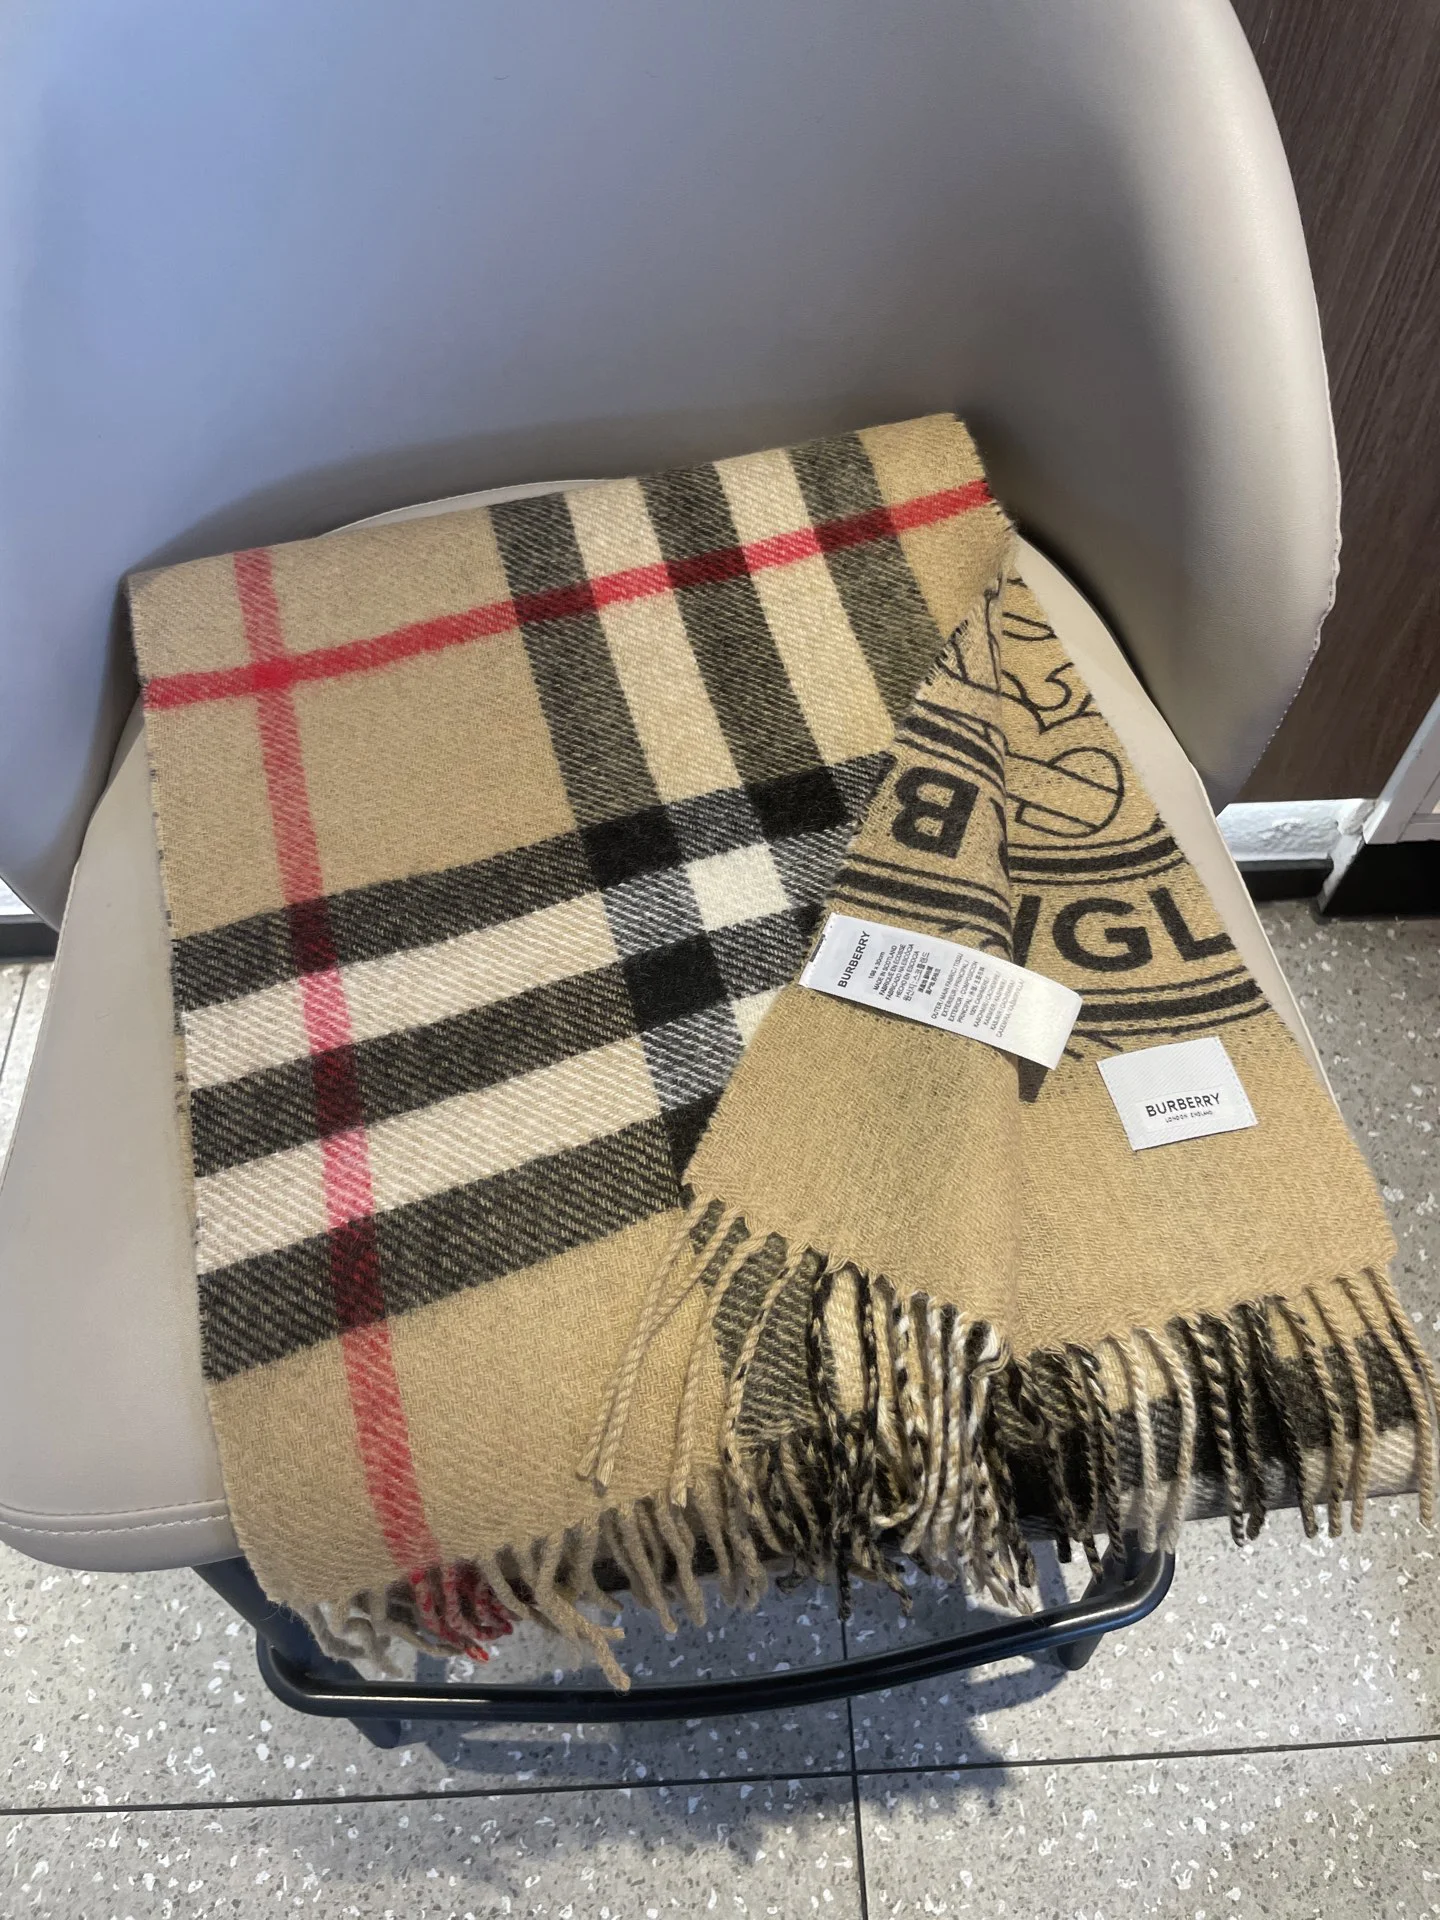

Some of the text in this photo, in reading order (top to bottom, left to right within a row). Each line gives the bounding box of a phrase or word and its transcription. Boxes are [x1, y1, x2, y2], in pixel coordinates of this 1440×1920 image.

[837, 930, 871, 988] BURBERRY
[872, 977, 884, 991] MADE
[882, 945, 898, 971] SCOTLAND
[885, 973, 902, 1001] FABRICADO
[944, 969, 957, 987] FABRIC
[895, 979, 908, 998] HECHO
[939, 987, 950, 1000] MAIN
[930, 1001, 943, 1020] OUTER
[1144, 1092, 1221, 1118] BURBERRY
[1164, 1110, 1214, 1123] LONDON ENGLAND
